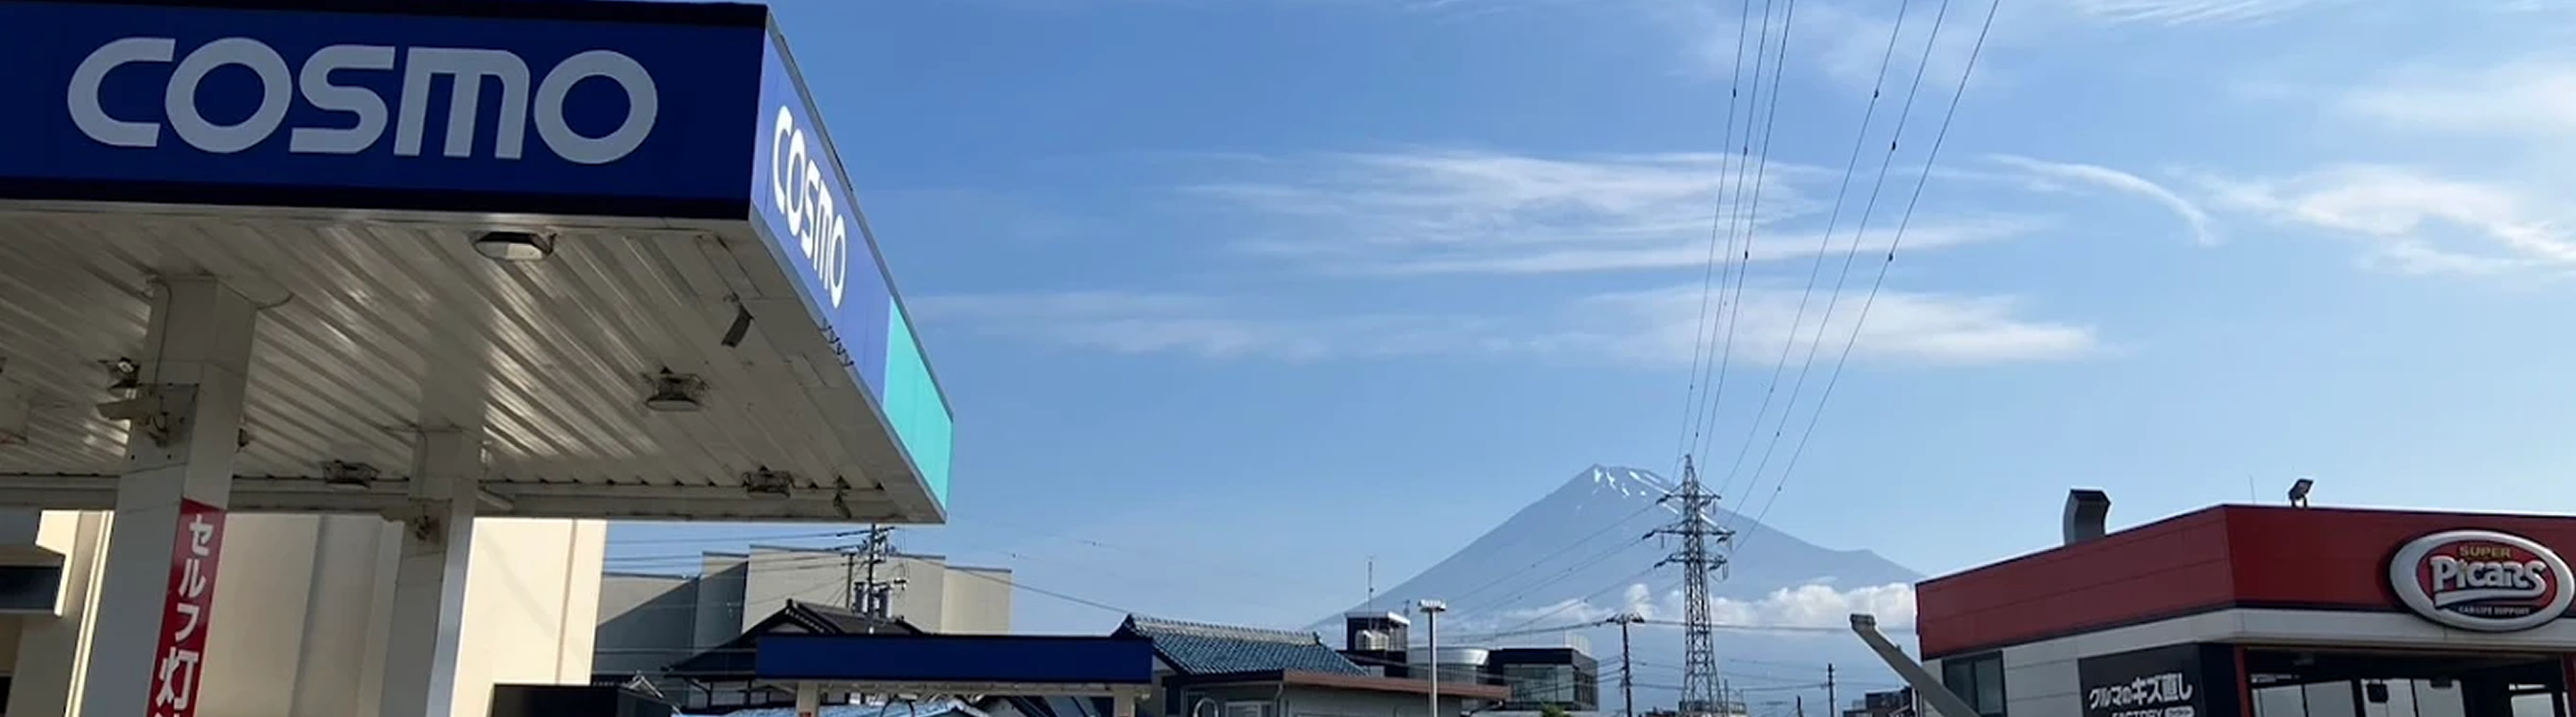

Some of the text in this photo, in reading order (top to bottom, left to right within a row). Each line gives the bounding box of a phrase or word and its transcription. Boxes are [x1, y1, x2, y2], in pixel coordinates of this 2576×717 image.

[67, 37, 658, 164] COSMO
[774, 105, 846, 308] COSMO
[154, 513, 214, 717] セルフ灯
[2460, 546, 2511, 558] SUPER
[2089, 672, 2192, 710] クルマのキズ直し
